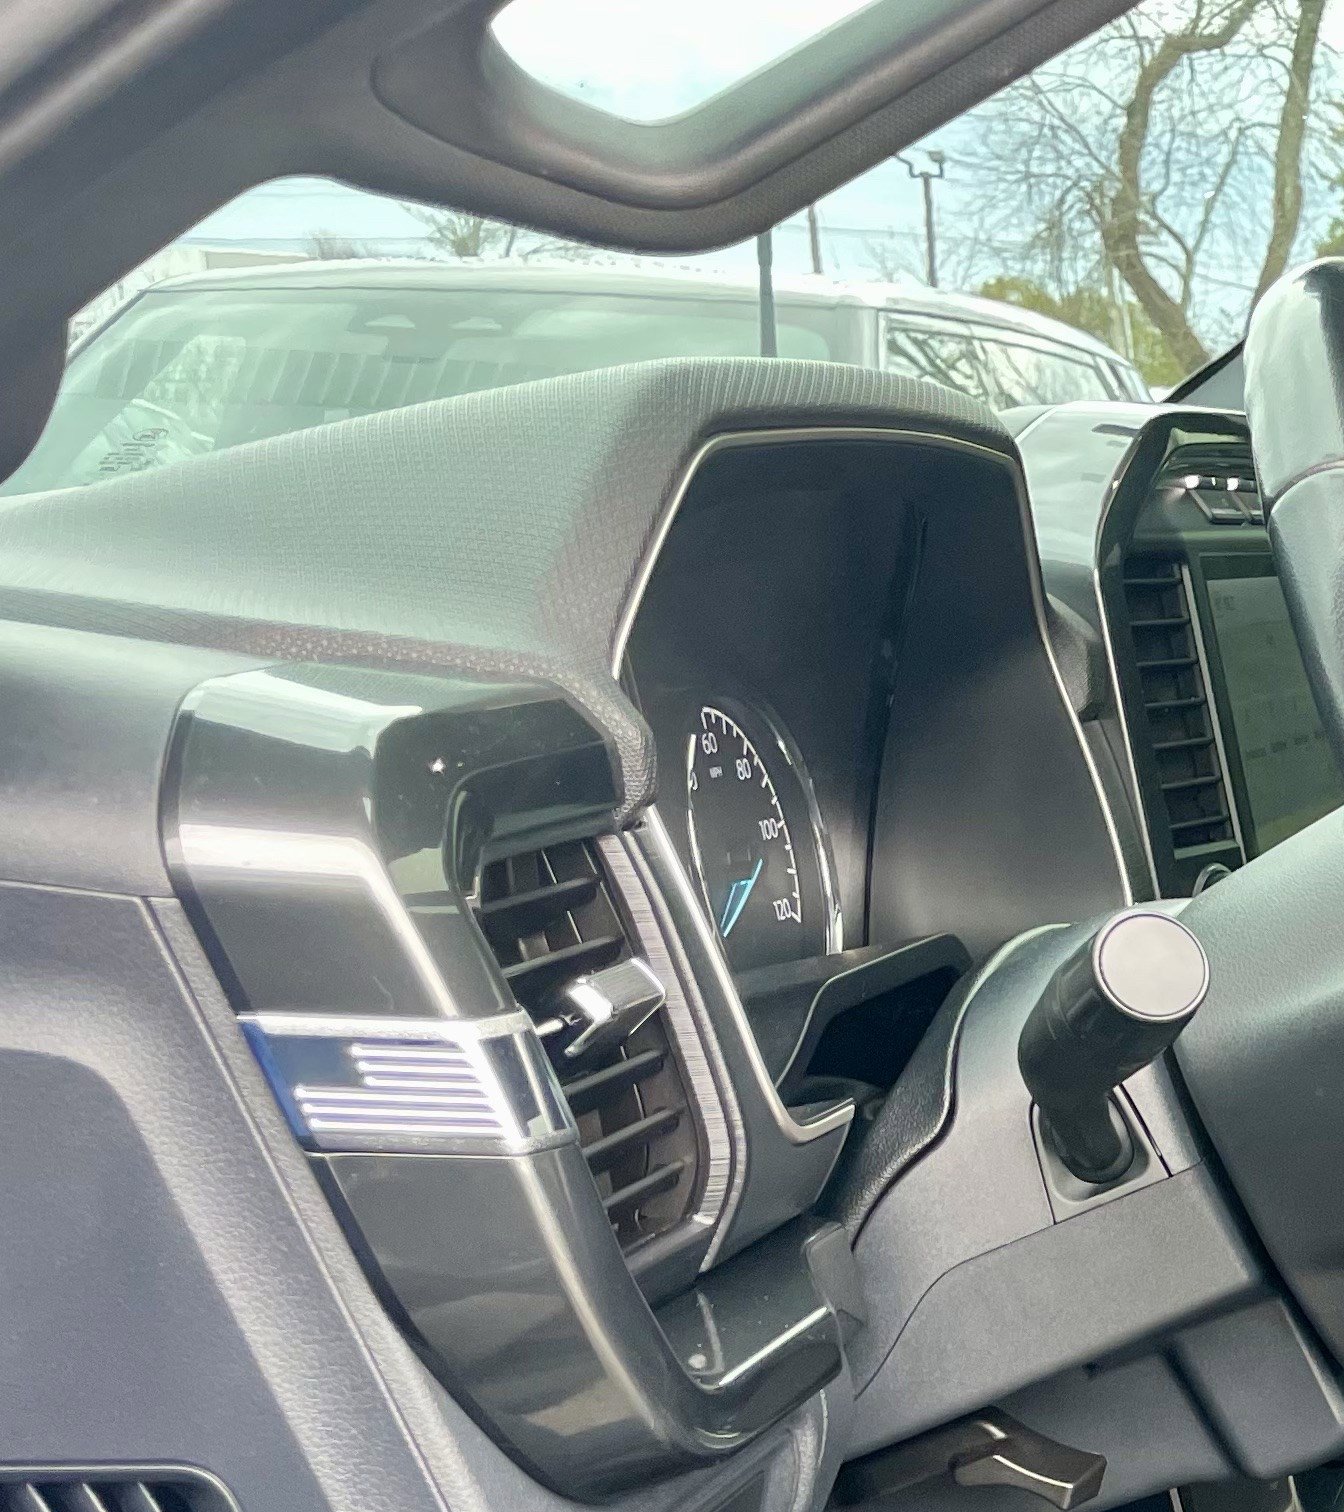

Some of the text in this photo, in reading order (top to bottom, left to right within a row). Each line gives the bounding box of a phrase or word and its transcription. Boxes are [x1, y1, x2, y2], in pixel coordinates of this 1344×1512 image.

[701, 732, 718, 755] 60
[735, 758, 752, 780] 80
[758, 817, 779, 841] 100
[773, 897, 792, 921] 120
